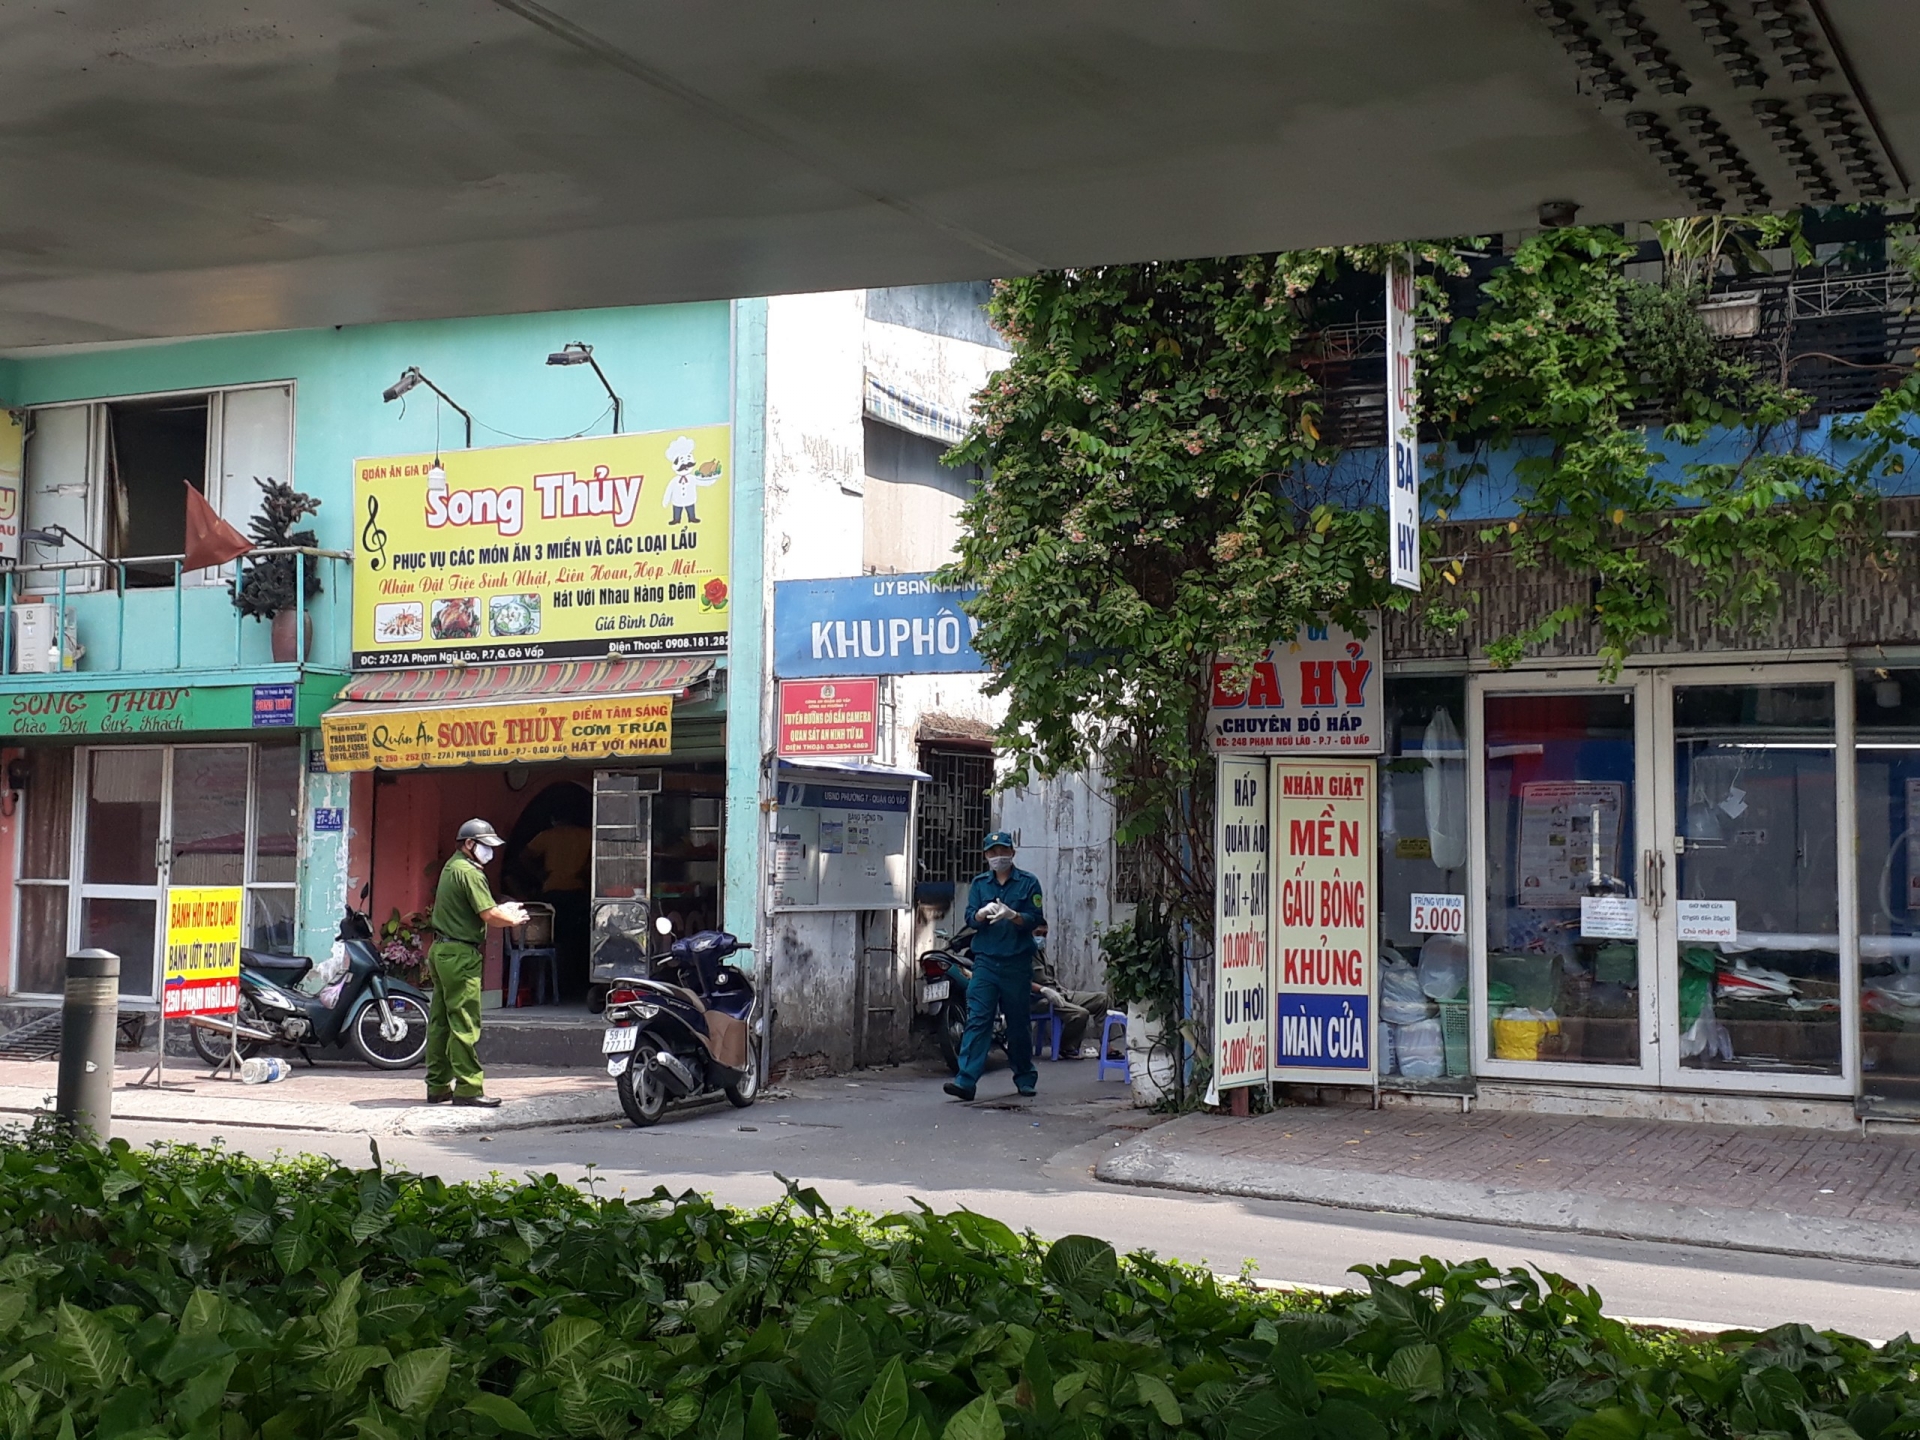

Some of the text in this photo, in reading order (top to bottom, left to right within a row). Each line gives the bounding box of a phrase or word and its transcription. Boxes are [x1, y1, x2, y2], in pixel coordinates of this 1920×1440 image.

[362, 465, 419, 481] QUÁN ĂN GIA
[425, 465, 644, 536] Song Thủy
[393, 526, 698, 572] PHỤC VỤ CÁC MÓN ĂN 3 MIỀN VÀ CÁC LOẠI LẨU
[1397, 508, 1415, 573] HỶ
[379, 579, 415, 596] Nhận
[419, 576, 444, 595] Đặt
[449, 574, 475, 593] Tiệc
[479, 571, 508, 589] Sinh
[555, 566, 584, 583] Liên
[553, 581, 696, 608] Hát Với Nhau Hàng Đêm
[595, 613, 674, 631] Giá Bình Dân
[379, 653, 409, 664] 27-27A
[411, 651, 437, 666] Phạm
[524, 645, 544, 659] Vấp
[609, 641, 631, 653] Điện
[633, 640, 663, 653] Thoại:
[1300, 642, 1372, 708] HỶ
[8, 693, 87, 715] SONG
[572, 704, 668, 720] ĐIỂM TÂM SÁNG
[13, 713, 184, 734] Chào Đón Quý Khách
[372, 720, 433, 751] Quán Ăn
[437, 707, 568, 748] SONG THỦY
[572, 720, 667, 736] CƠM TRƯA
[1223, 711, 1362, 733] CHUYÊN ĐỒ HẤP
[571, 737, 667, 752] HÁT VỚI NHAU
[1232, 737, 1247, 746] 248
[1250, 737, 1273, 748] PHẠM
[1276, 735, 1293, 746] NGŨ
[1296, 735, 1311, 745] LÃO
[1319, 736, 1331, 745] P.7
[1340, 735, 1351, 745] GÒ
[1354, 733, 1370, 745] VẤP
[1234, 771, 1257, 807] HẤP
[1283, 771, 1365, 802] NHẬN GIẶT
[1253, 819, 1265, 853] ÁO
[1290, 803, 1359, 857] MỀN
[1224, 859, 1265, 927] GIẶT SẤY
[1282, 860, 1365, 928] GẤU BÔNG
[172, 897, 191, 929] BÁNH
[205, 902, 219, 927] HEO
[220, 901, 238, 929] QUAY
[1414, 906, 1461, 932] 5.000
[169, 939, 188, 971] BÁNH
[204, 943, 217, 969] HEO
[219, 942, 237, 970] QUAY
[1284, 934, 1363, 987] KHỦNG
[181, 987, 203, 1015] PHẠM
[1224, 977, 1264, 1025] ỦI HƠI
[1282, 1004, 1322, 1057] MÀN
[1327, 1000, 1364, 1059] CỬA
